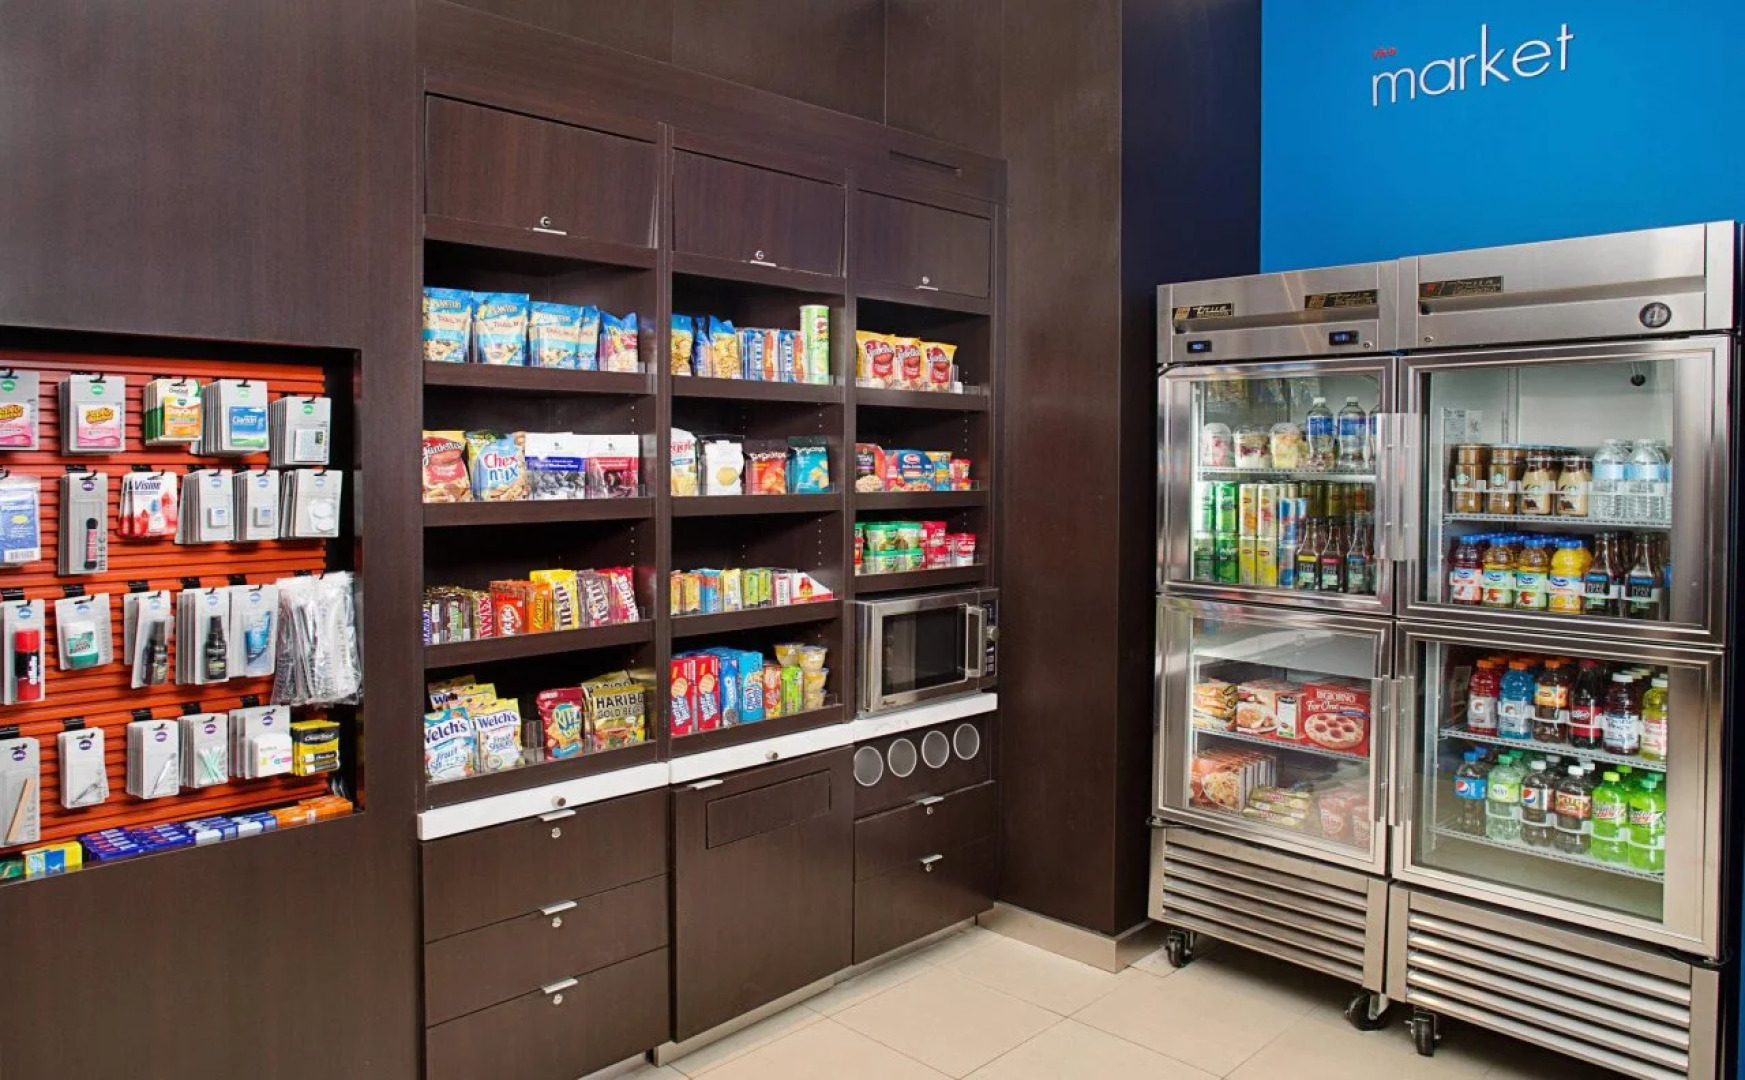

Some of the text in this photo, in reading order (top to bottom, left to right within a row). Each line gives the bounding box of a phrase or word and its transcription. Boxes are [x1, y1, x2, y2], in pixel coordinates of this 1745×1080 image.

[1372, 23, 1574, 107] market
[483, 452, 519, 469] Chex
[489, 467, 519, 481] mix
[477, 712, 518, 729] Welch's
